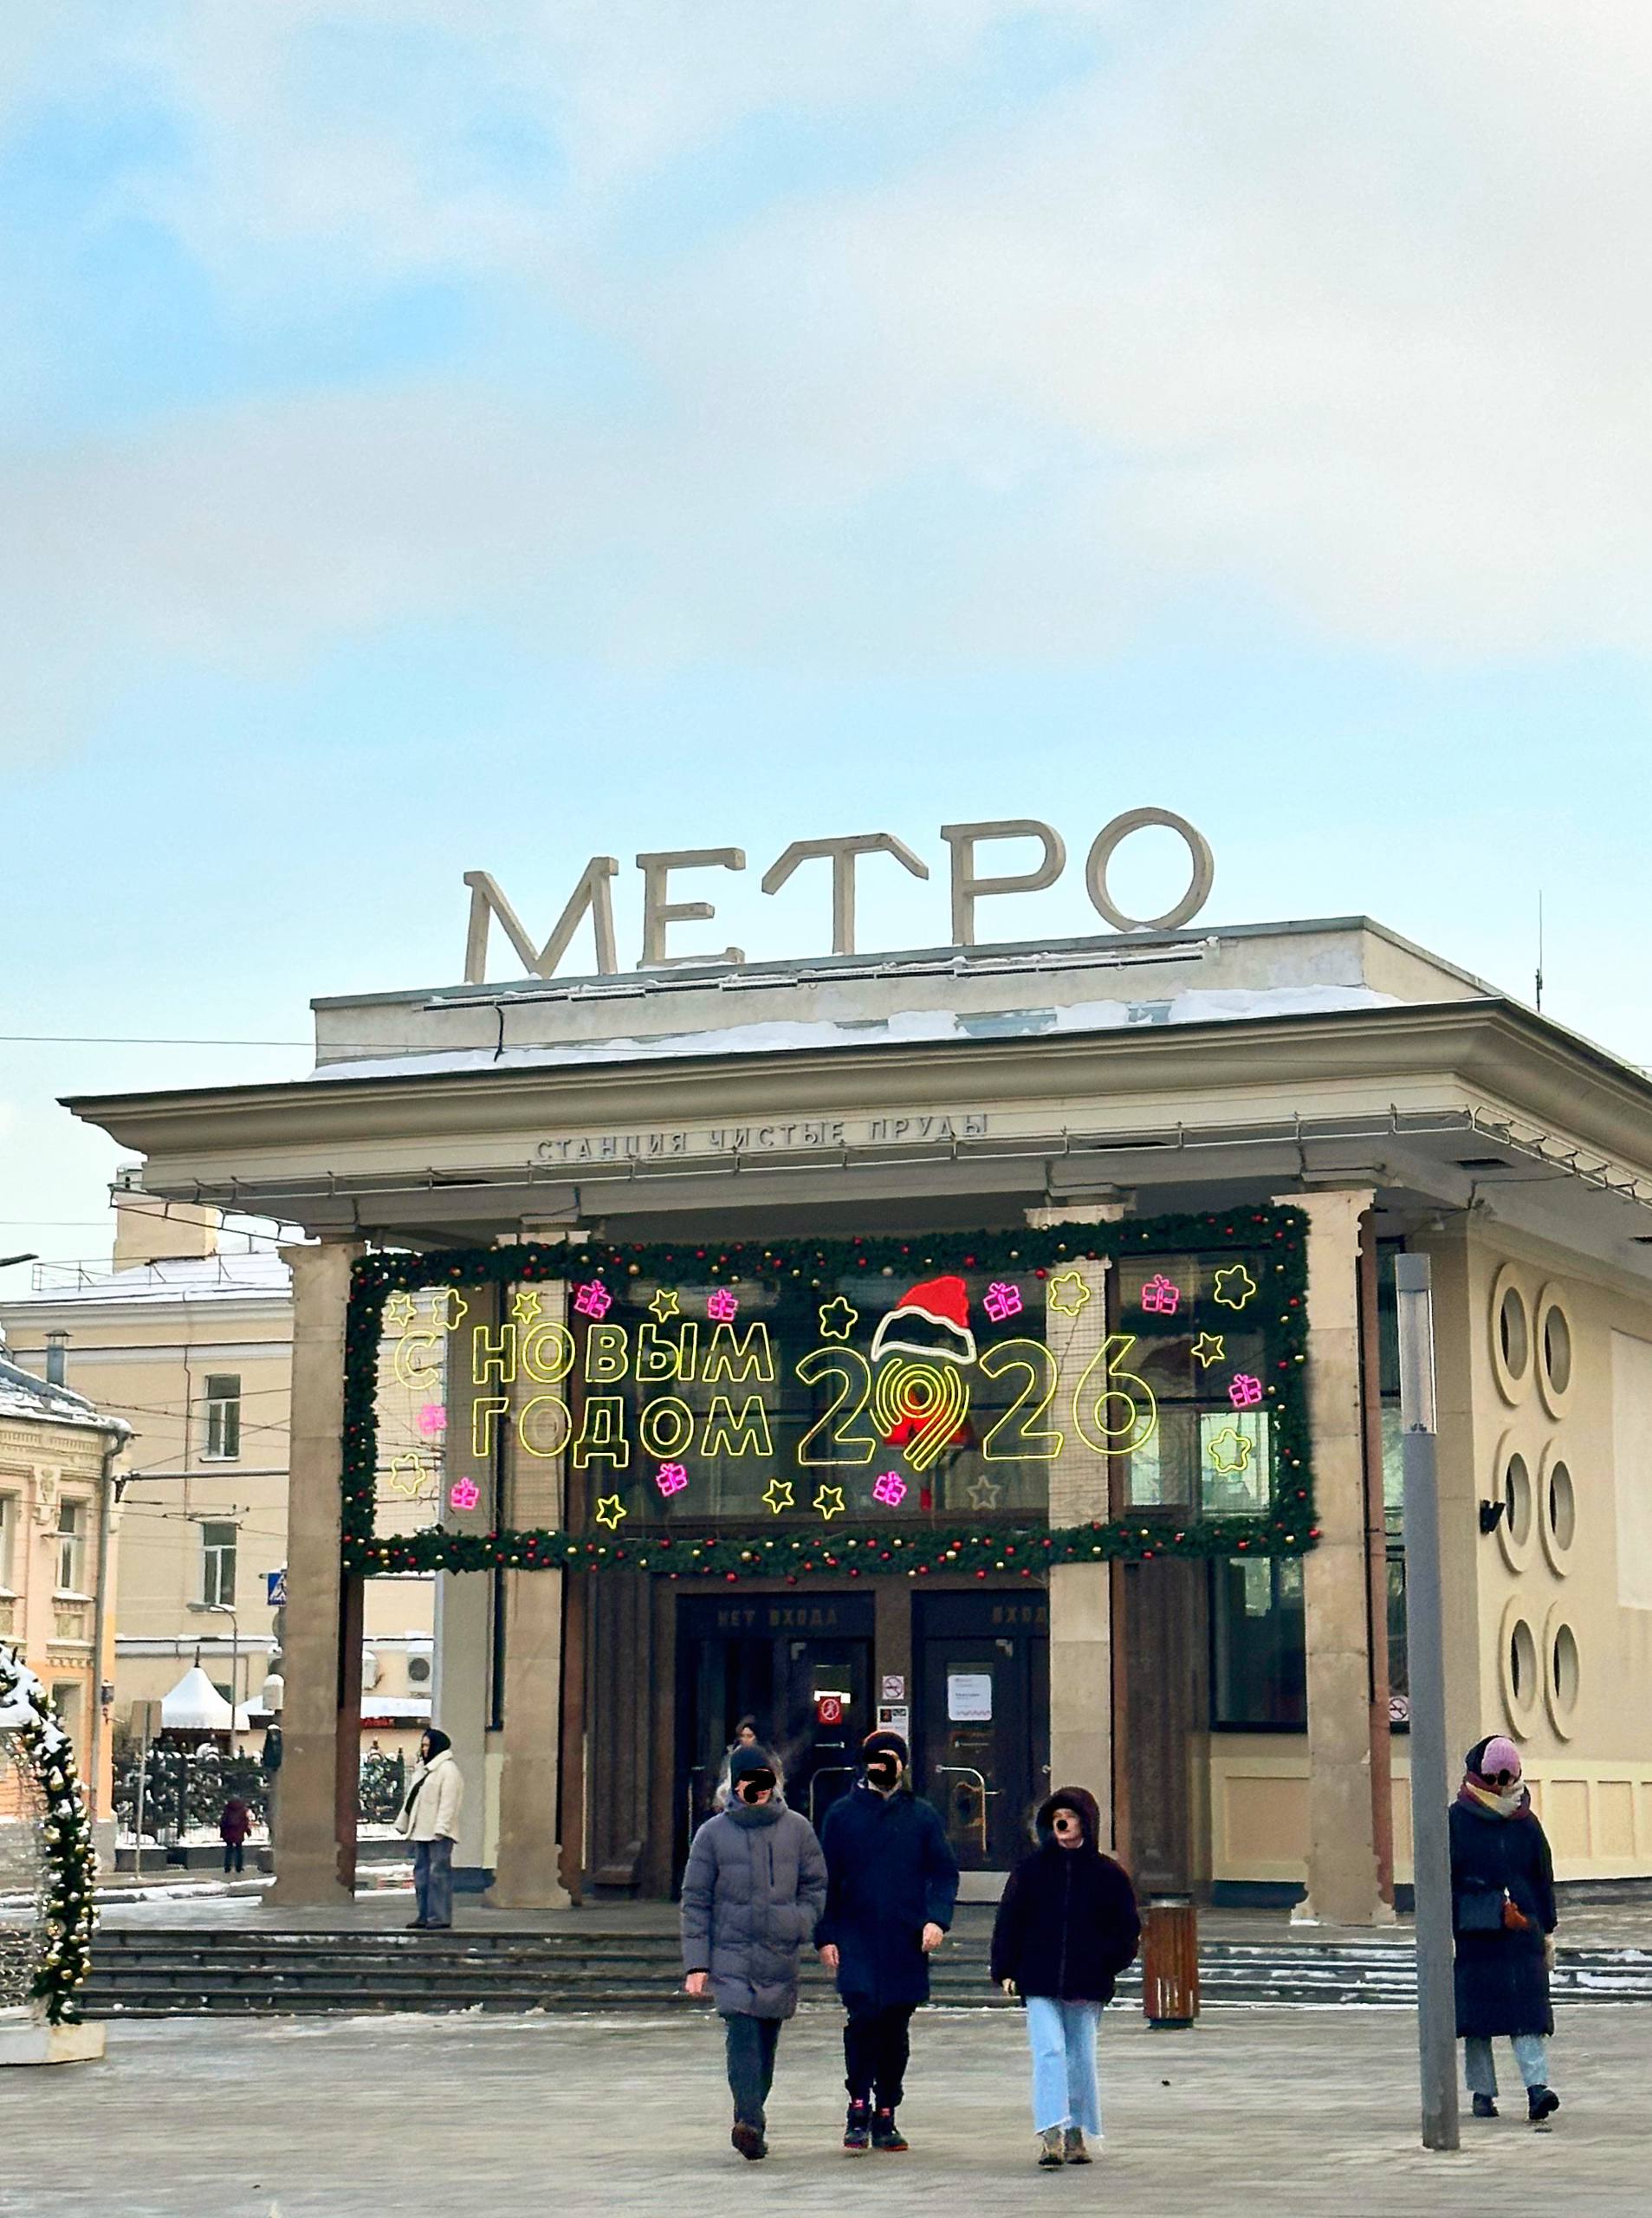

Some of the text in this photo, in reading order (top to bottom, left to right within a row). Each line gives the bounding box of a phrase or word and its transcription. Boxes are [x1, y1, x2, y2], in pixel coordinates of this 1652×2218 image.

[463, 807, 1215, 985] МЕТРО
[537, 1113, 988, 1159] СТАНЦИЯ ЧИСТЫЕ ПРУДЫ
[394, 1321, 775, 1390] С НОВЫМ
[471, 1395, 774, 1469] ГОДОМ
[717, 1607, 839, 1627] НЕТ ВХОДА
